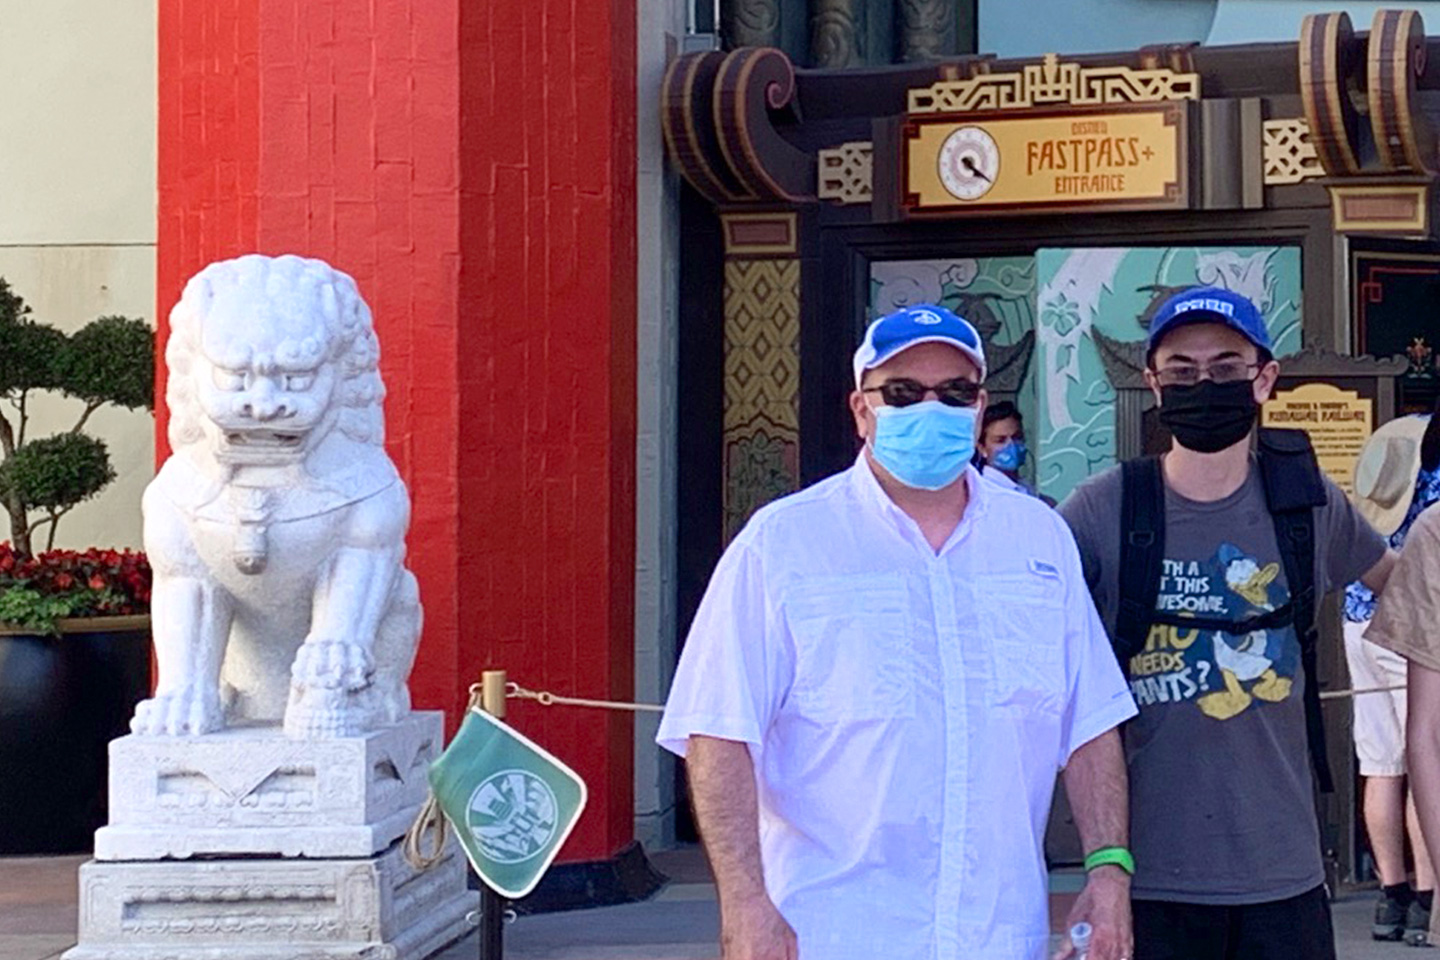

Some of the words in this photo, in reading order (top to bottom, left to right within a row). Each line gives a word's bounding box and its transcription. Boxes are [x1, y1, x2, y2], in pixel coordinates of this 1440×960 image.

[1027, 137, 1154, 176] FASTPASS+
[1055, 174, 1125, 195] ENTRANCE
[1188, 561, 1199, 576] A
[1174, 576, 1210, 594] THIS
[1156, 593, 1228, 614] WESOME,
[1145, 614, 1199, 652] HO
[1130, 651, 1185, 675] NEEDS
[1130, 660, 1211, 705] ANTS?
